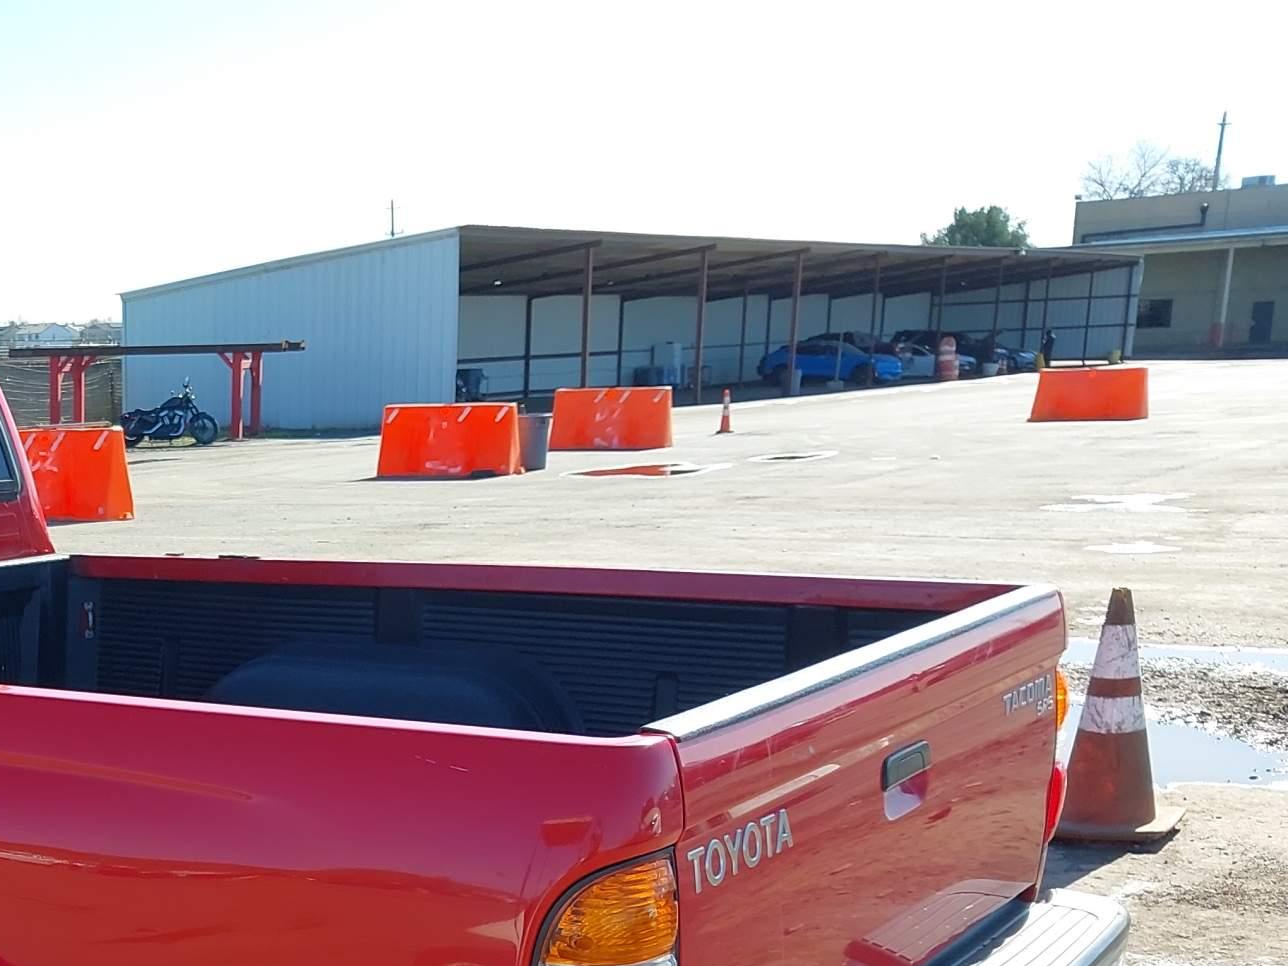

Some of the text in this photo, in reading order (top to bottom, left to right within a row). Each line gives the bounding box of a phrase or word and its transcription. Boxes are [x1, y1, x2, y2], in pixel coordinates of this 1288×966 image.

[1002, 674, 1052, 717] TACOMA
[1036, 695, 1054, 716] SR5
[686, 807, 794, 895] TOYOTA
